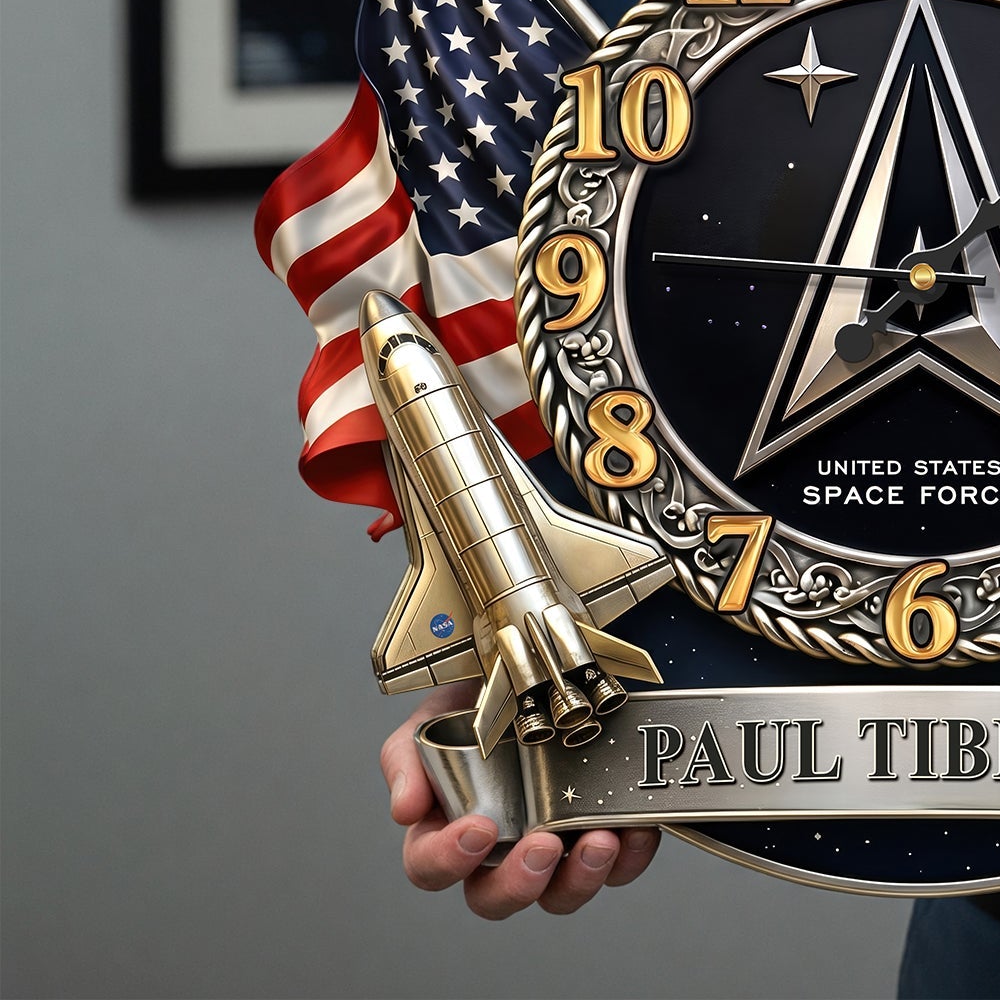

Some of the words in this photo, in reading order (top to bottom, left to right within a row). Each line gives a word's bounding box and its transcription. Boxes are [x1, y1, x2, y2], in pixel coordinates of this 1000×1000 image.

[561, 61, 694, 164] 10
[533, 230, 608, 333] 9
[581, 387, 660, 491] 8
[817, 459, 902, 476] UNITED
[802, 485, 905, 506] SPACE
[704, 511, 777, 615] 7
[882, 560, 961, 663] 6
[637, 718, 842, 789] PAUL
